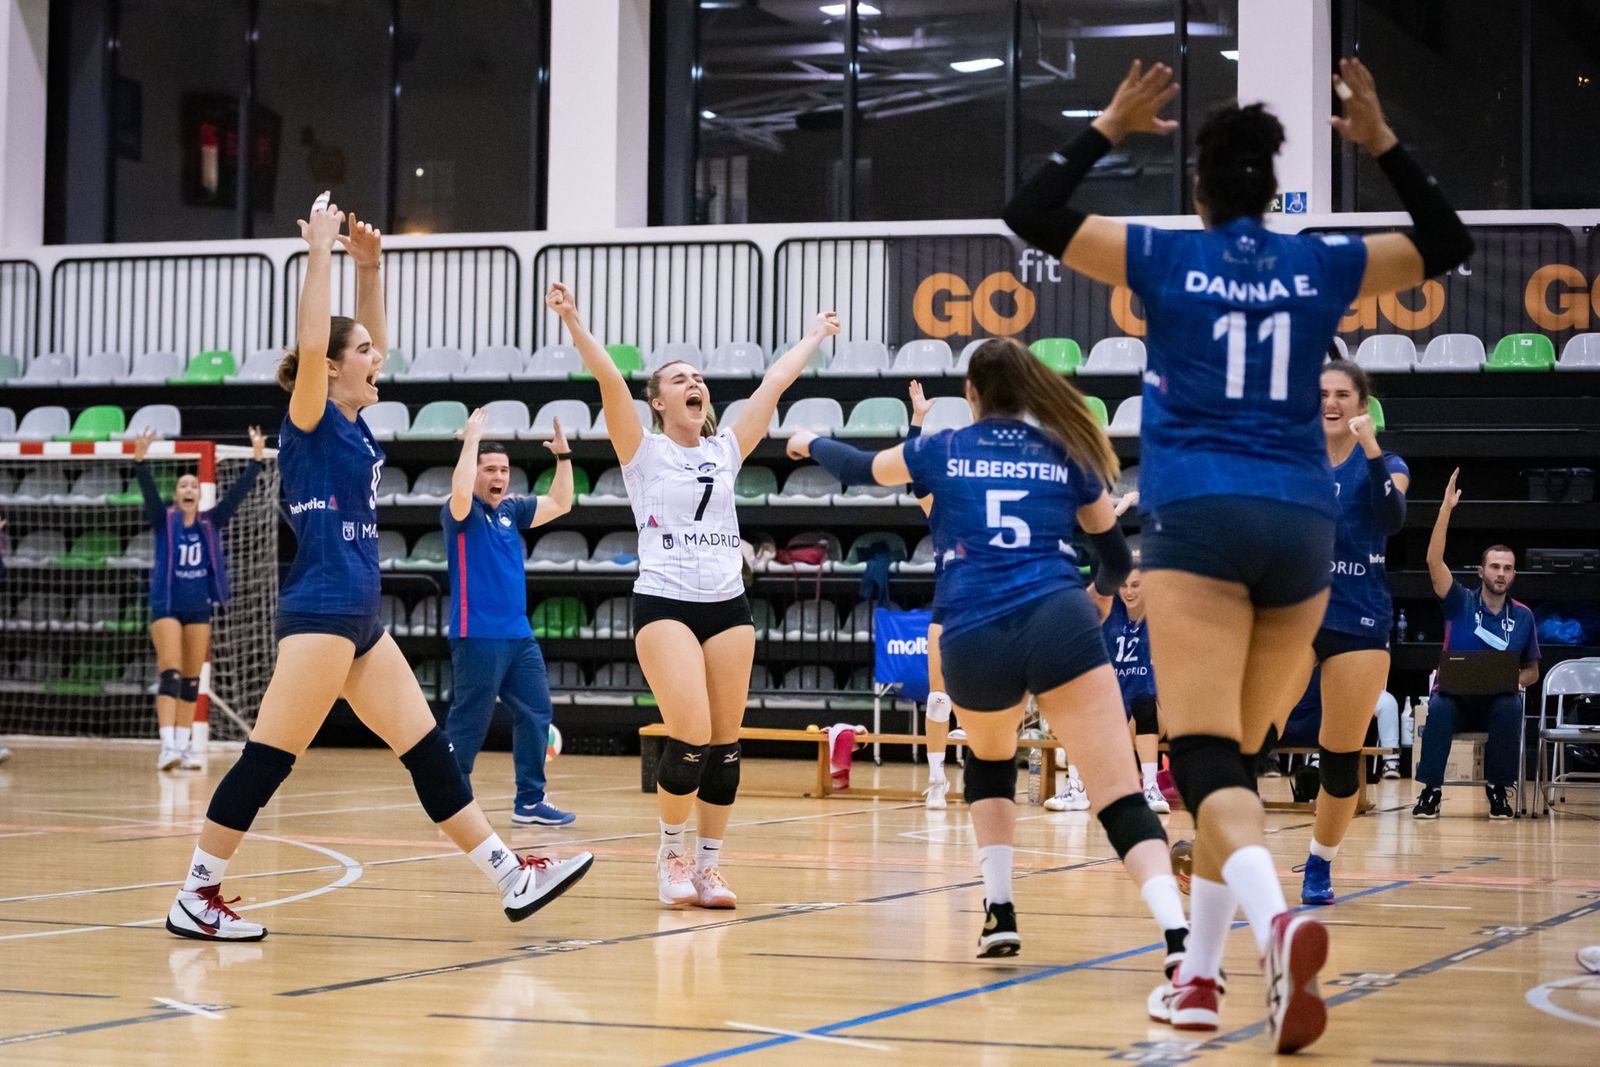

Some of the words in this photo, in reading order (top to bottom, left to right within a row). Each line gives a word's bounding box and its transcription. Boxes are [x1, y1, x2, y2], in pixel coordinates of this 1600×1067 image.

[1018, 249, 1062, 283] fit
[1185, 270, 1290, 304] DANNA
[1293, 274, 1318, 297] E.
[1524, 263, 1600, 331] G
[912, 271, 1036, 338] GO
[1213, 311, 1291, 400] 11
[946, 458, 1069, 485] SILBERSTEIN
[694, 476, 715, 521] 7
[985, 489, 1031, 549] 5
[178, 542, 202, 567] 10
[684, 533, 741, 548] MADRID
[887, 636, 928, 656] molt
[1115, 635, 1140, 663] 12
